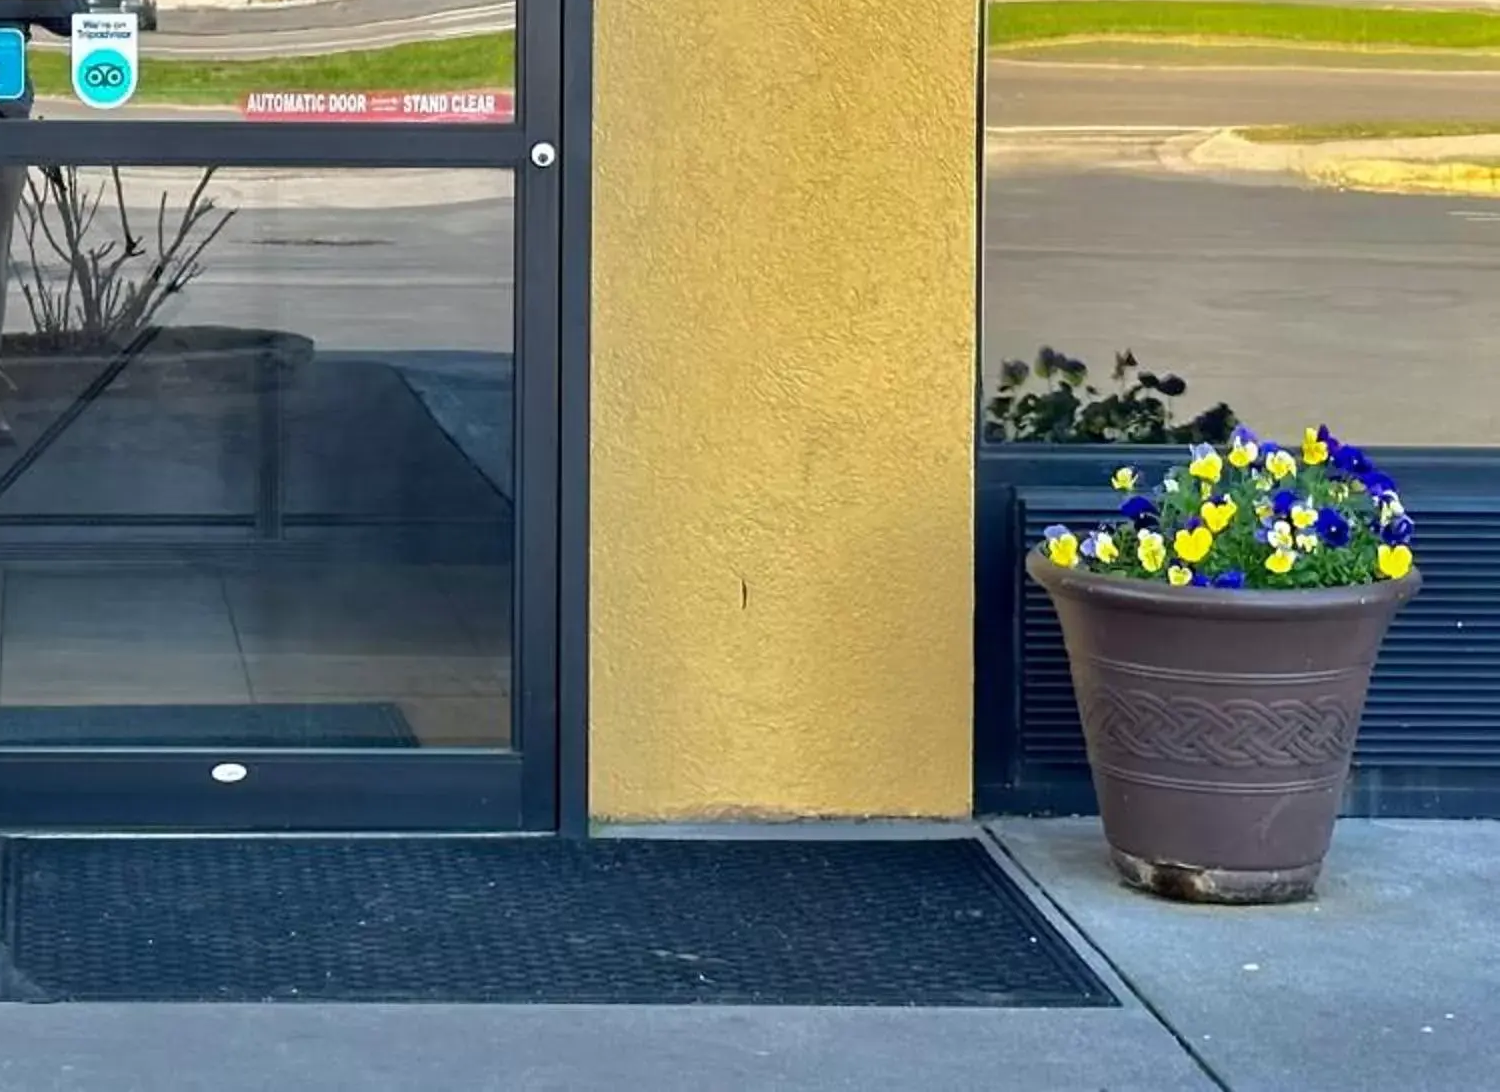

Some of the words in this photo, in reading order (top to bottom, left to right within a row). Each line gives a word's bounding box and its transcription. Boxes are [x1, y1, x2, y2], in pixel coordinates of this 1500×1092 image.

[247, 93, 325, 113] AUTOMATIC
[329, 94, 367, 113] DOOR
[403, 95, 448, 113] STAND
[451, 95, 496, 113] CLEAR
